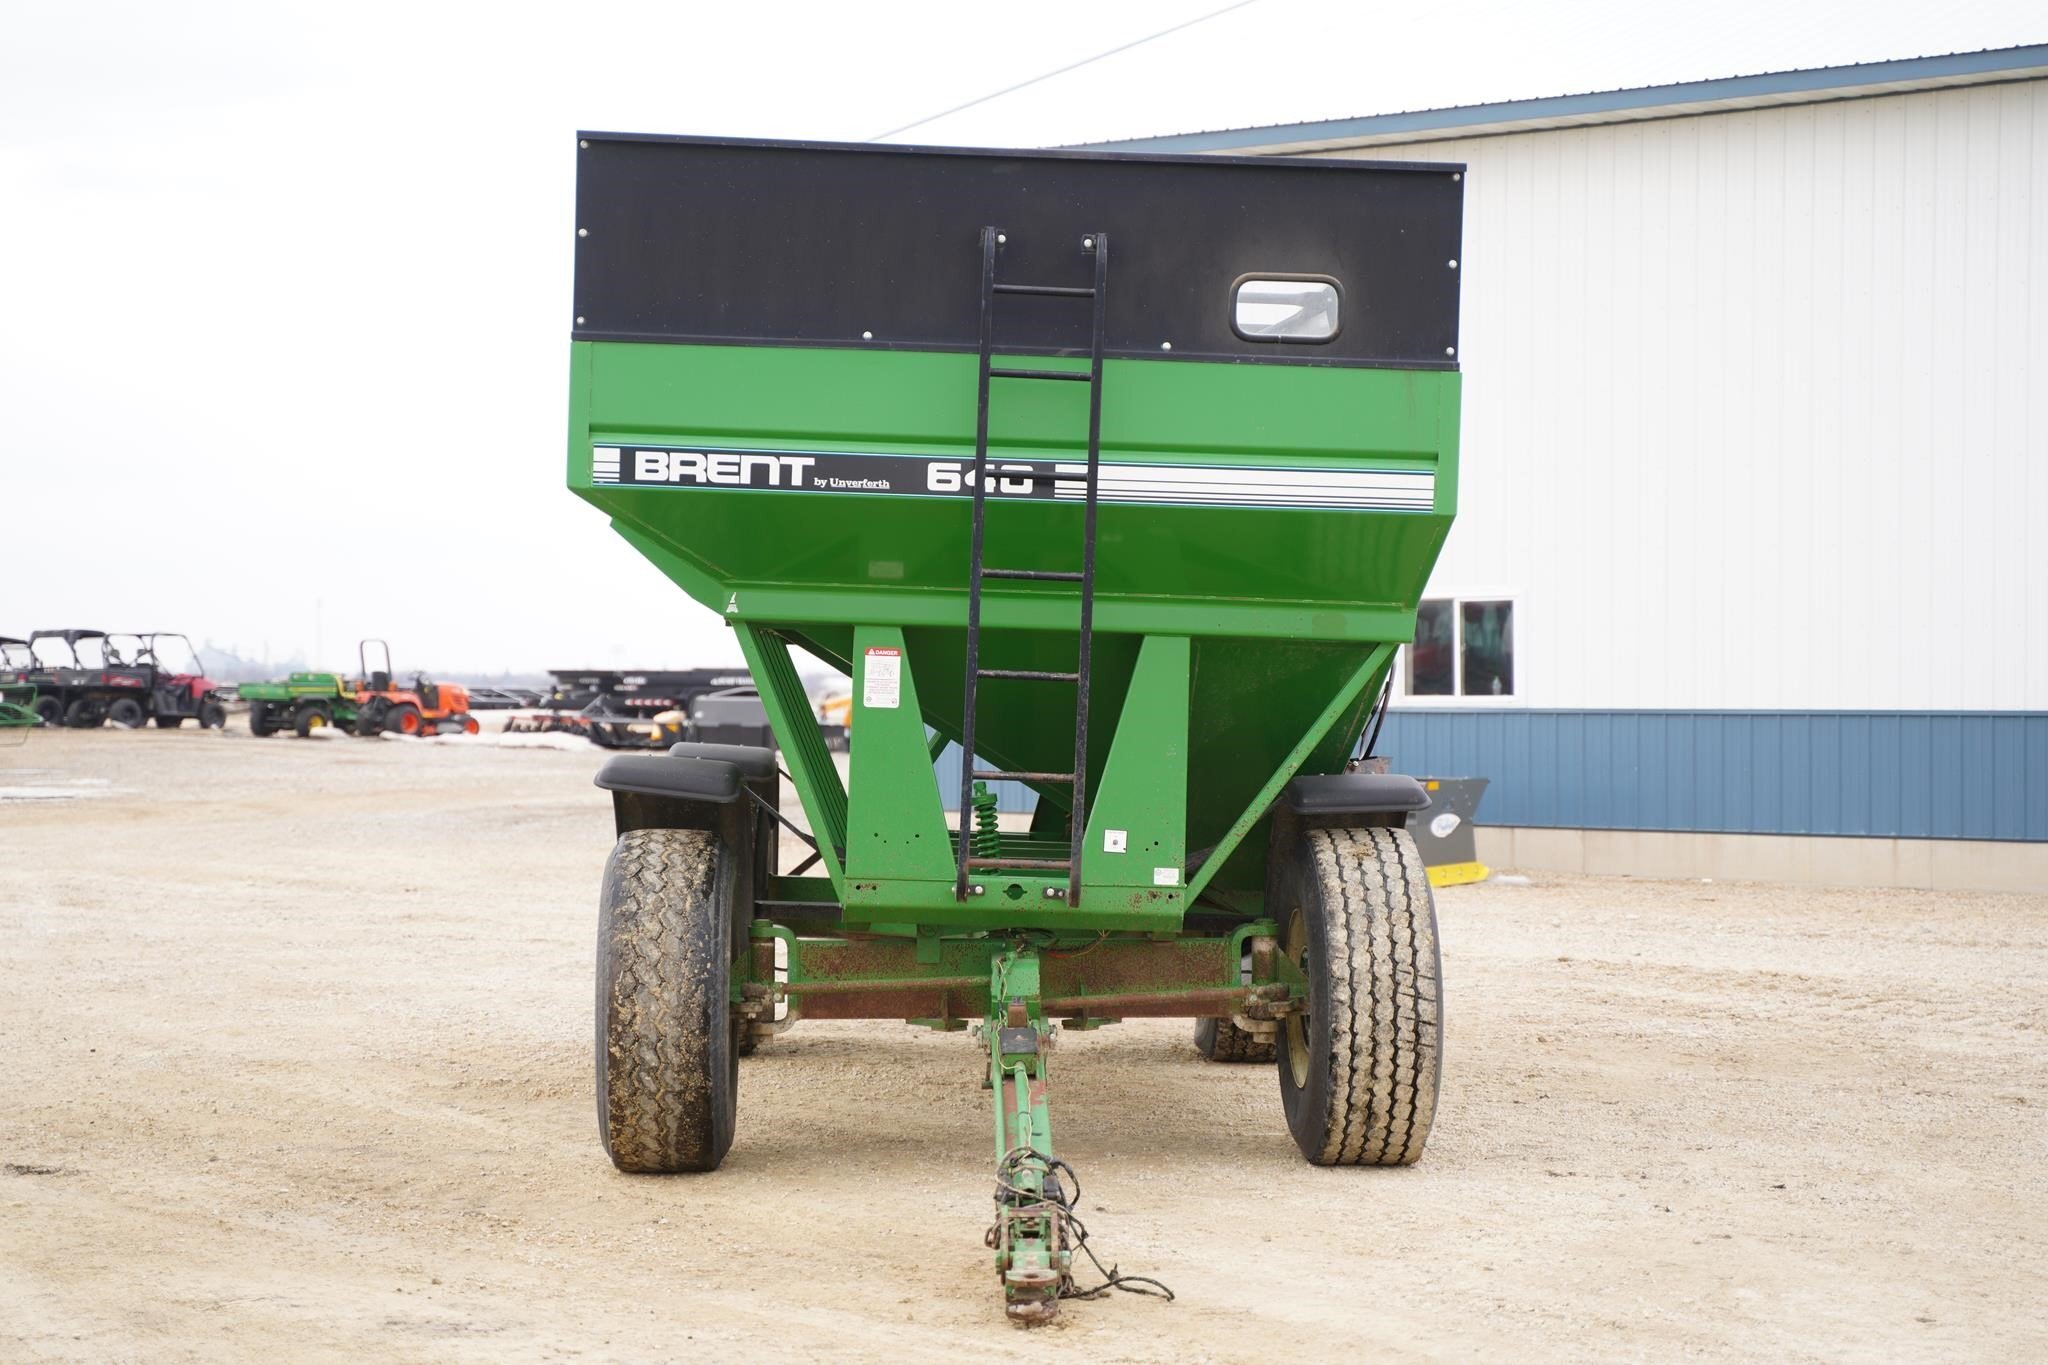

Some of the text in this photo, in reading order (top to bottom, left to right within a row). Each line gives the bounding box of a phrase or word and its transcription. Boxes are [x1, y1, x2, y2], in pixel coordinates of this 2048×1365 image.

[634, 450, 891, 490] BRENT by Unverferth
